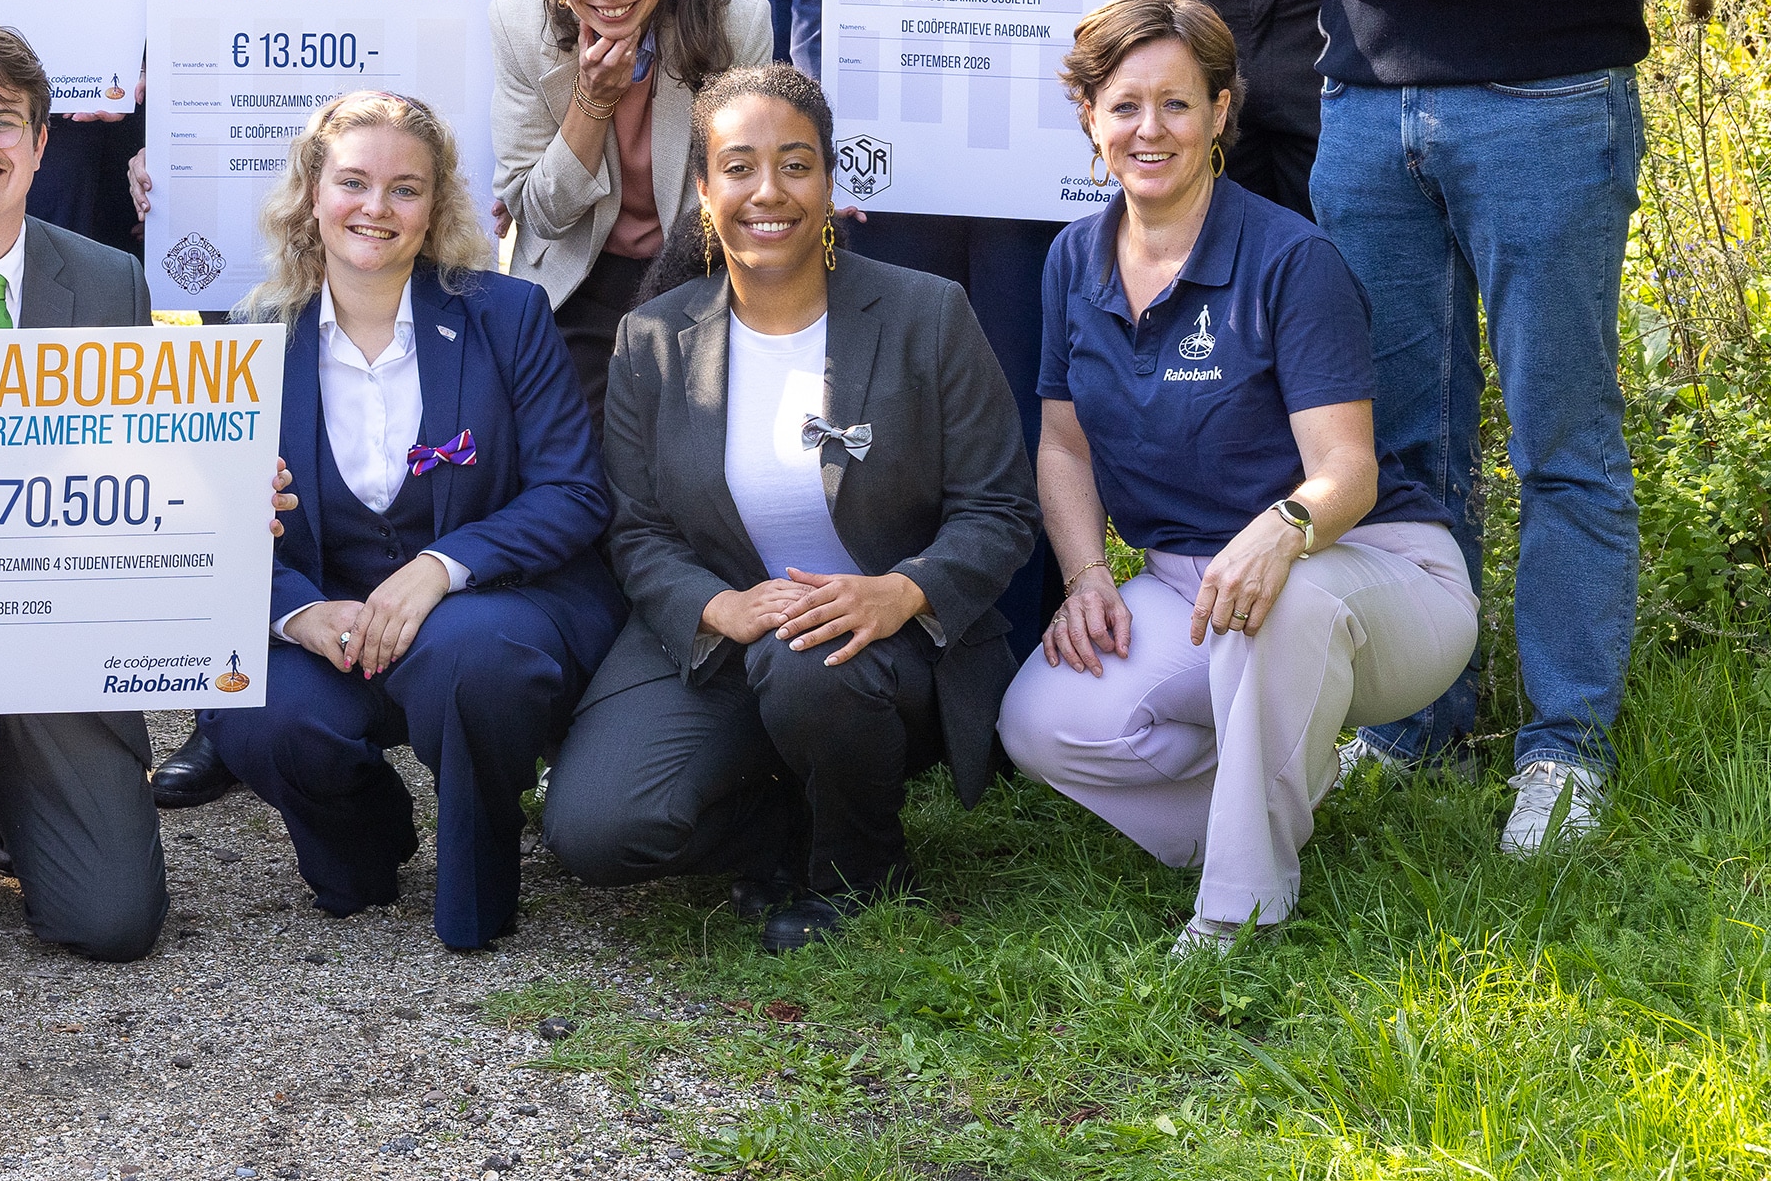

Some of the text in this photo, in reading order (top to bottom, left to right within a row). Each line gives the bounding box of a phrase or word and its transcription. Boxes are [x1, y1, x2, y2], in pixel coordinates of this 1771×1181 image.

[901, 18, 1051, 38] DE COÖPERATIEVE RABOBANK
[232, 33, 379, 73] € 13.500,-
[839, 57, 862, 65] Datum:
[900, 53, 991, 70] SEPTEMBER 2026
[51, 74, 103, 85] coöperatieve
[50, 86, 102, 99] abobank
[230, 94, 313, 108] VERDUURZAMING
[230, 126, 243, 139] DE
[840, 138, 887, 178] SSR
[1060, 175, 1072, 185] de
[1060, 188, 1114, 203] Raboba
[1163, 366, 1223, 382] Rabobank
[122, 411, 261, 443] TOEKOMST
[53, 557, 61, 571] 4
[64, 553, 214, 571] STUDENTENVERENIGINGEN
[22, 600, 52, 615] 2026
[104, 654, 212, 670] de coöperatieve
[103, 672, 211, 694] Rabobank
